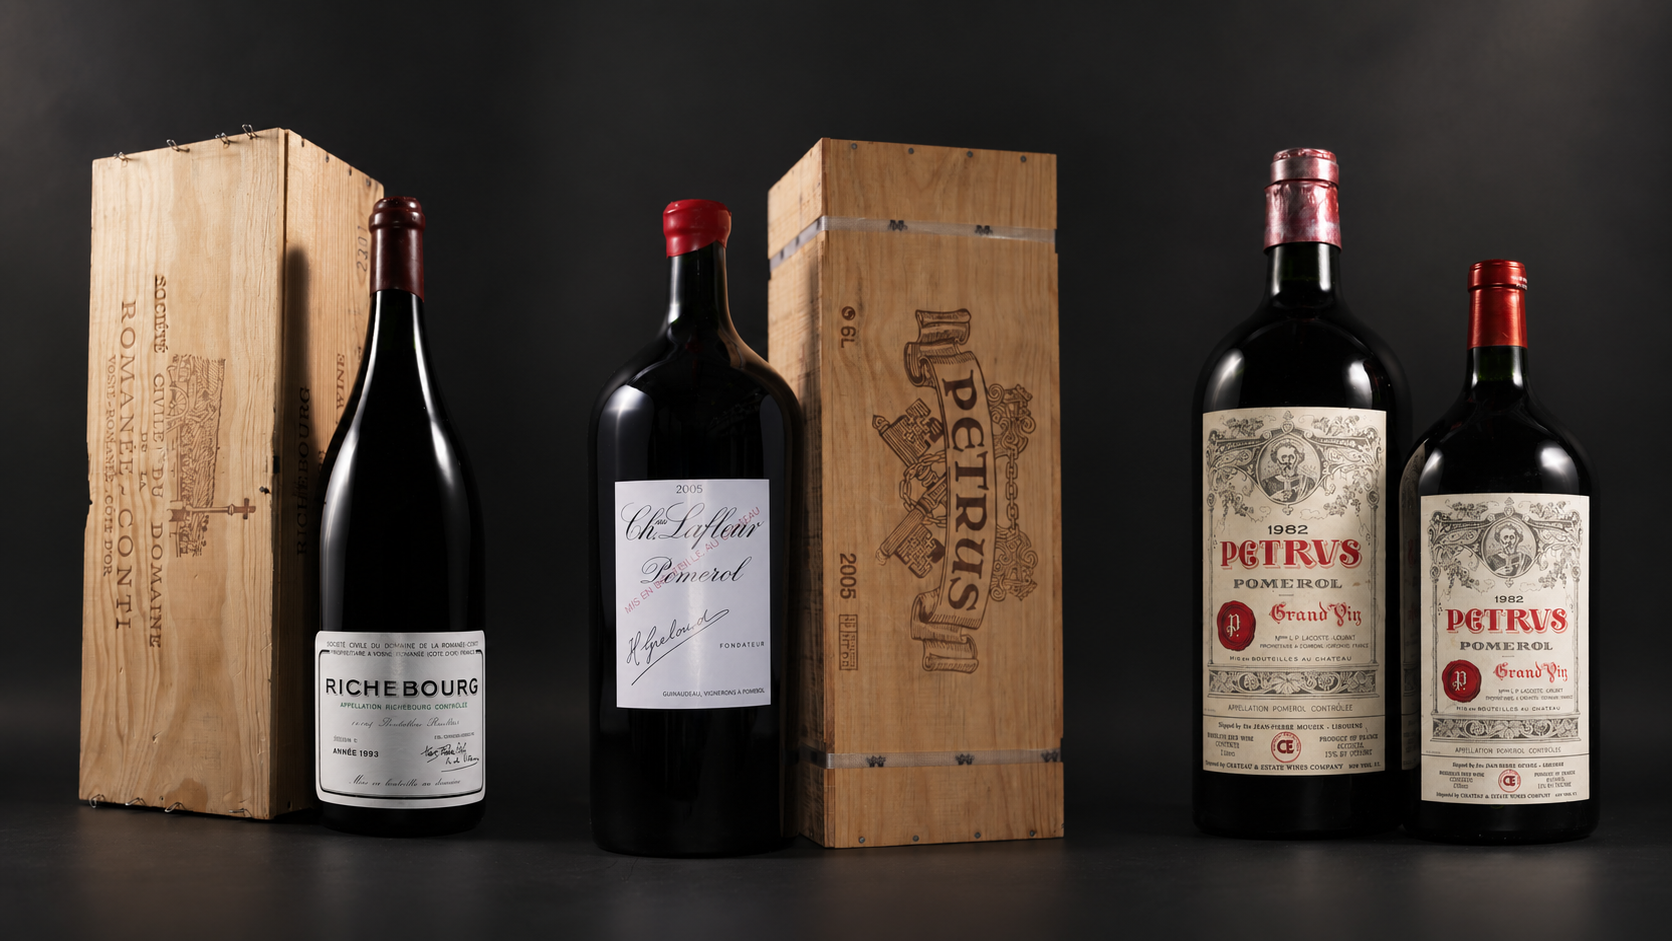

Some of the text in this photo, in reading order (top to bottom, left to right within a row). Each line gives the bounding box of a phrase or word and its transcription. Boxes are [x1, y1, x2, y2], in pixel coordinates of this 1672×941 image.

[840, 326, 856, 349] 6L
[152, 372, 165, 442] CIVILE
[296, 386, 310, 555] RICHEBOURG
[151, 467, 164, 498] DU
[676, 485, 703, 494] 2005
[941, 369, 990, 612] PETRUS
[658, 502, 765, 549] Lafleur
[1268, 524, 1308, 535] 1982
[1220, 538, 1363, 570] PETRVS
[624, 597, 641, 614] MIS
[640, 587, 654, 601] EN
[705, 538, 720, 551] AU
[640, 556, 752, 584] Pomerol
[840, 553, 857, 599] 2005
[148, 523, 163, 649] DOMAINE
[1233, 578, 1343, 589] POMEROL
[1494, 595, 1524, 604] 1982
[1269, 601, 1362, 627] Grand Vin
[1445, 608, 1568, 634] PETRVS
[719, 641, 765, 649] FONDATEUR
[1460, 641, 1553, 651] POMEROL
[1493, 661, 1568, 683] Grand Vin
[325, 677, 479, 697] RICHEBOURG
[703, 689, 737, 697] VIGNERONS
[340, 702, 382, 710] APPELLATION
[1228, 704, 1269, 712] APPELLATION
[333, 747, 379, 758] ANNÉE 1993
[1277, 739, 1294, 754] CE
